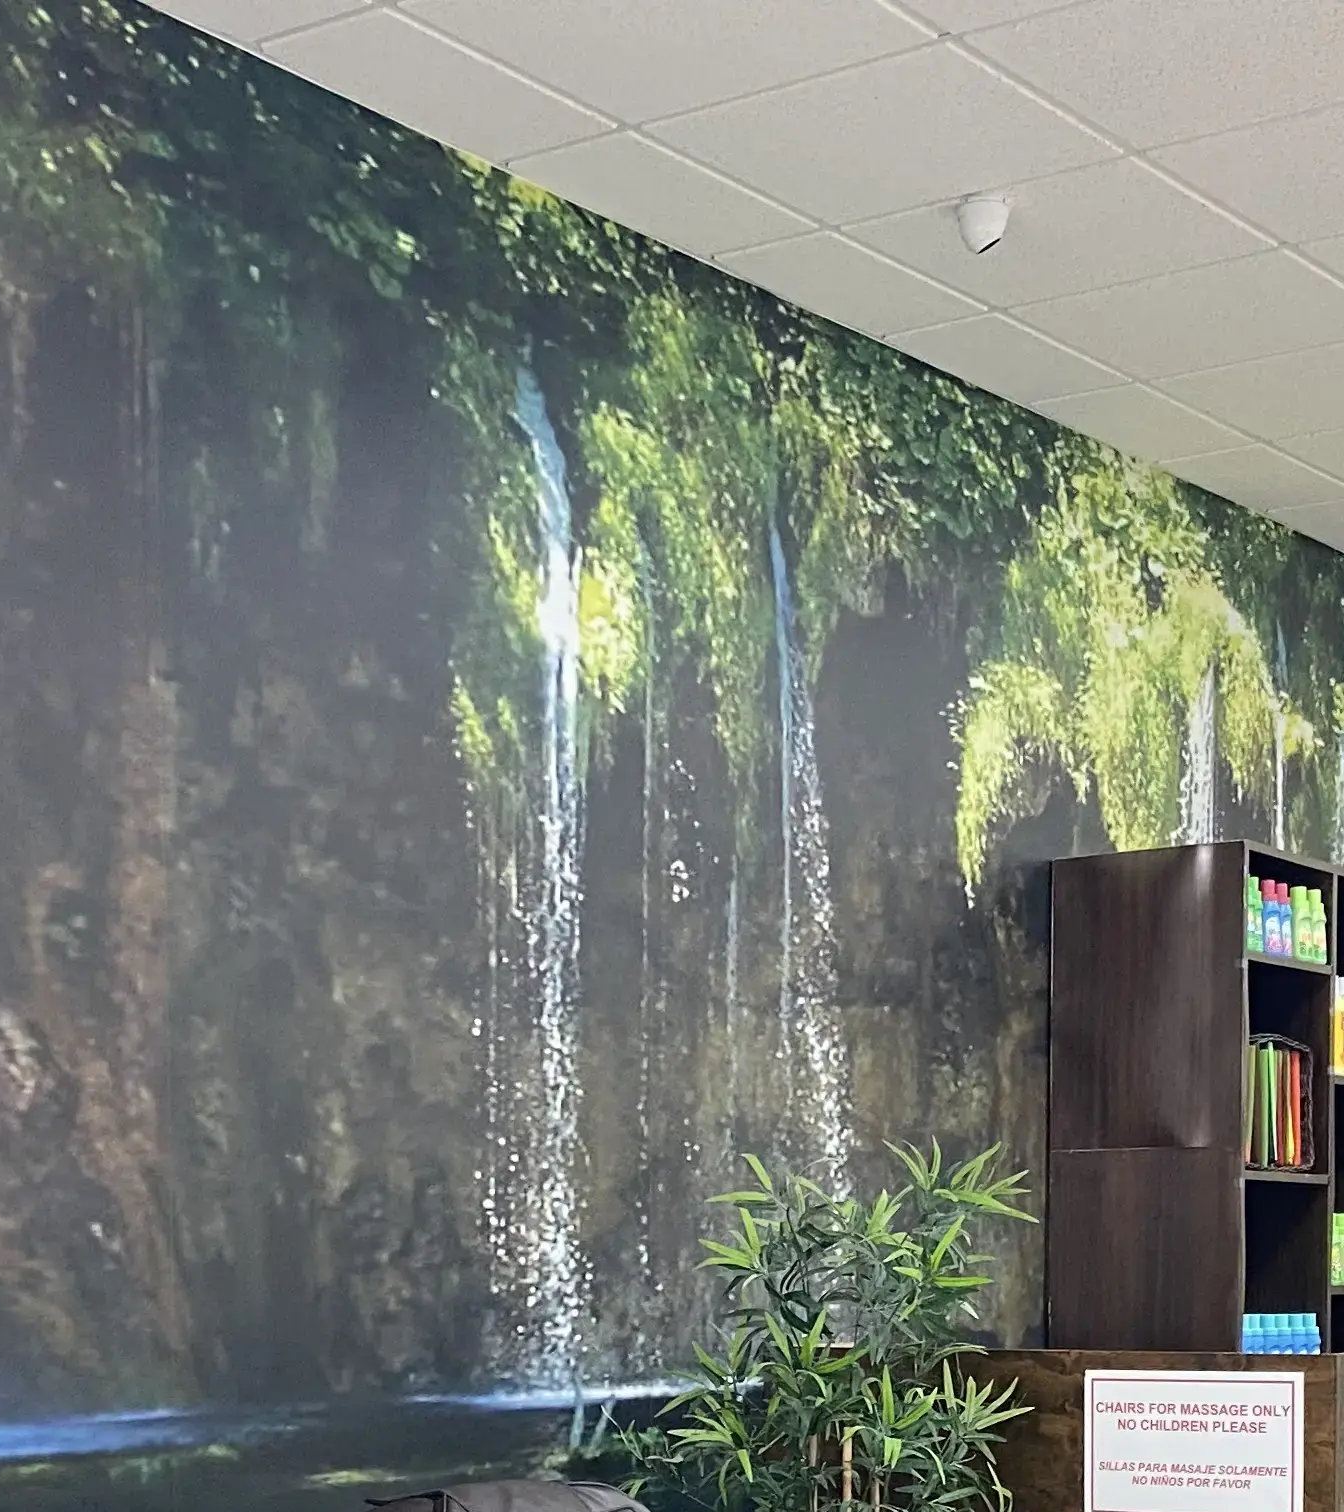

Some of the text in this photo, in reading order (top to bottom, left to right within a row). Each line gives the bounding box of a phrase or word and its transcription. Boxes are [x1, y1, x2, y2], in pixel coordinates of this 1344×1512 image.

[1095, 1402, 1291, 1417] CHAIRS FOR MASSAGE ONLY
[1117, 1419, 1267, 1434] NO CHILDREN PLEASE
[1098, 1461, 1288, 1477] SILLAS PARA MASAJE SOLAMENTE
[1132, 1475, 1252, 1489] NO NIÑOS POR FAVOR
